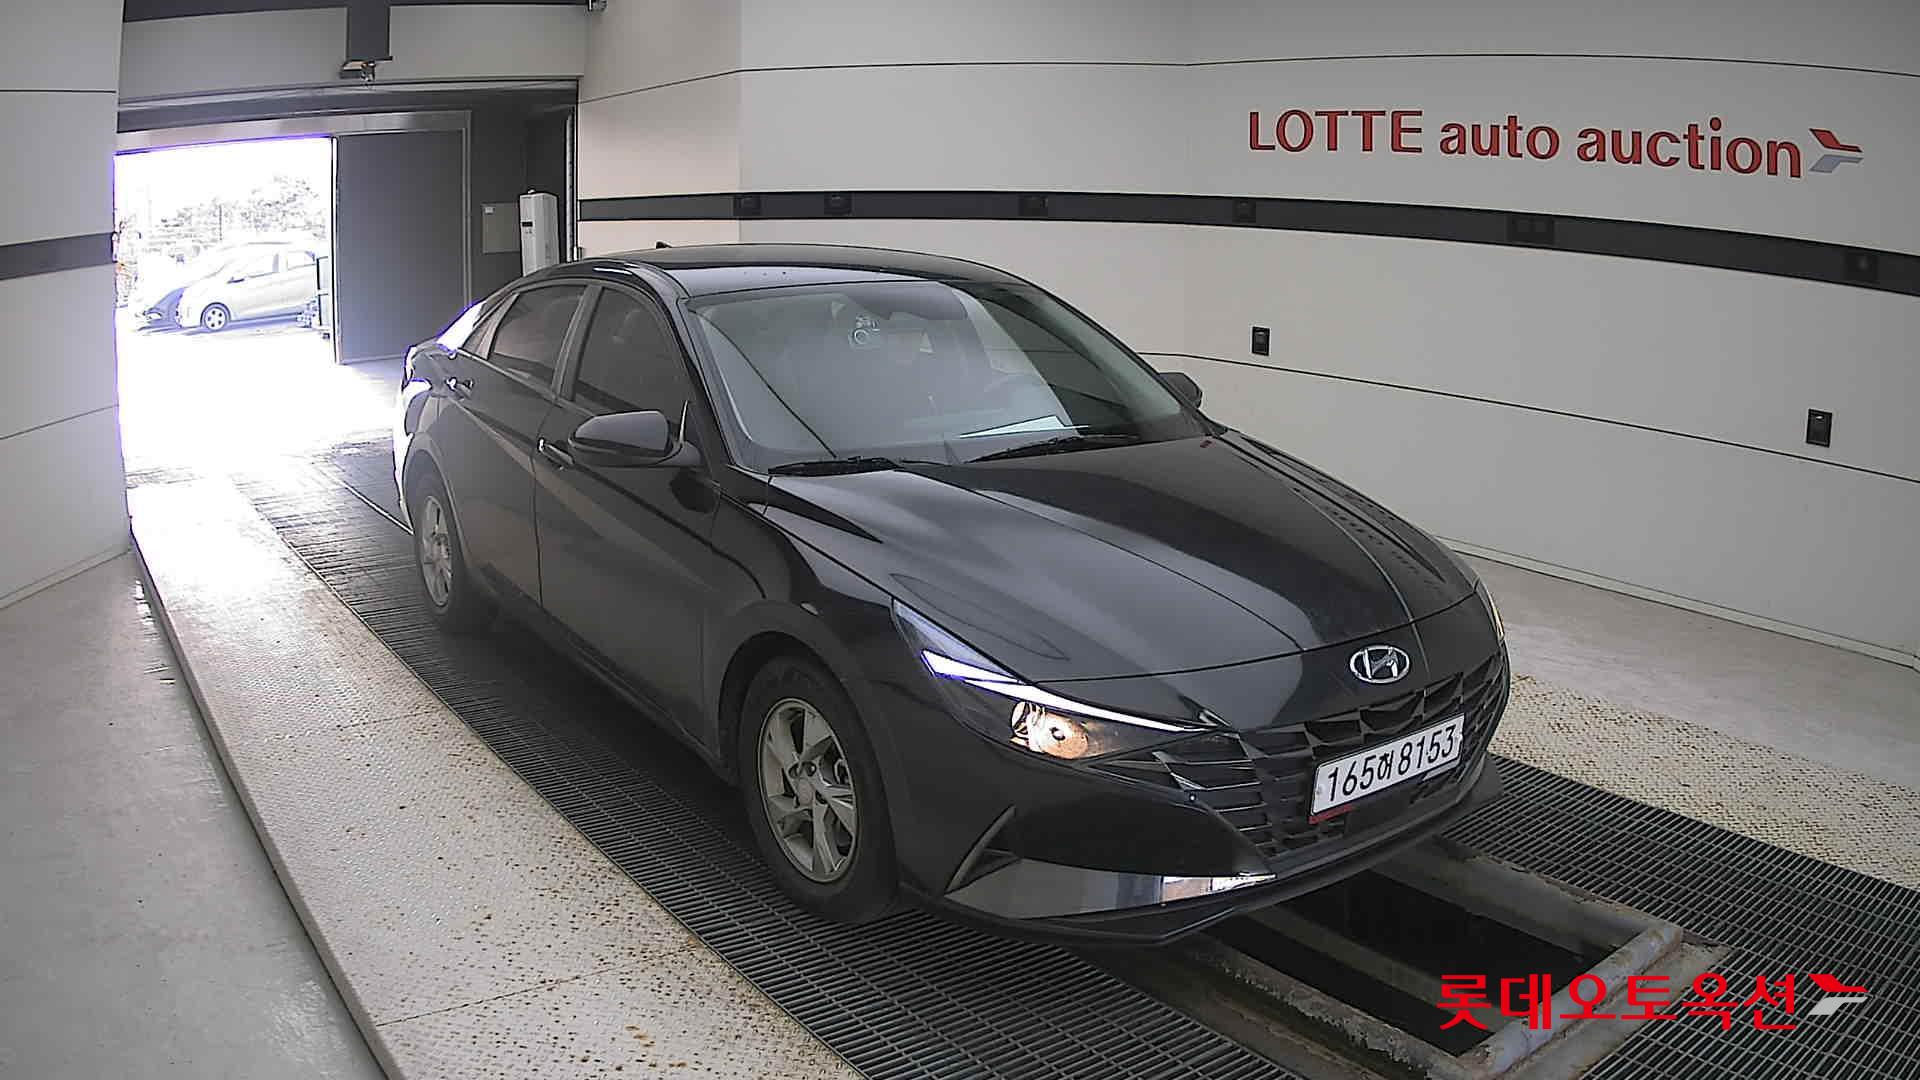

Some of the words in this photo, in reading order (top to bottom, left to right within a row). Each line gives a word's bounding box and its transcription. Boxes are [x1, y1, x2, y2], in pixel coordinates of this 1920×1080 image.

[1249, 111, 1423, 153] LOTTE
[1440, 115, 1560, 158] auto
[1577, 117, 1802, 178] auction
